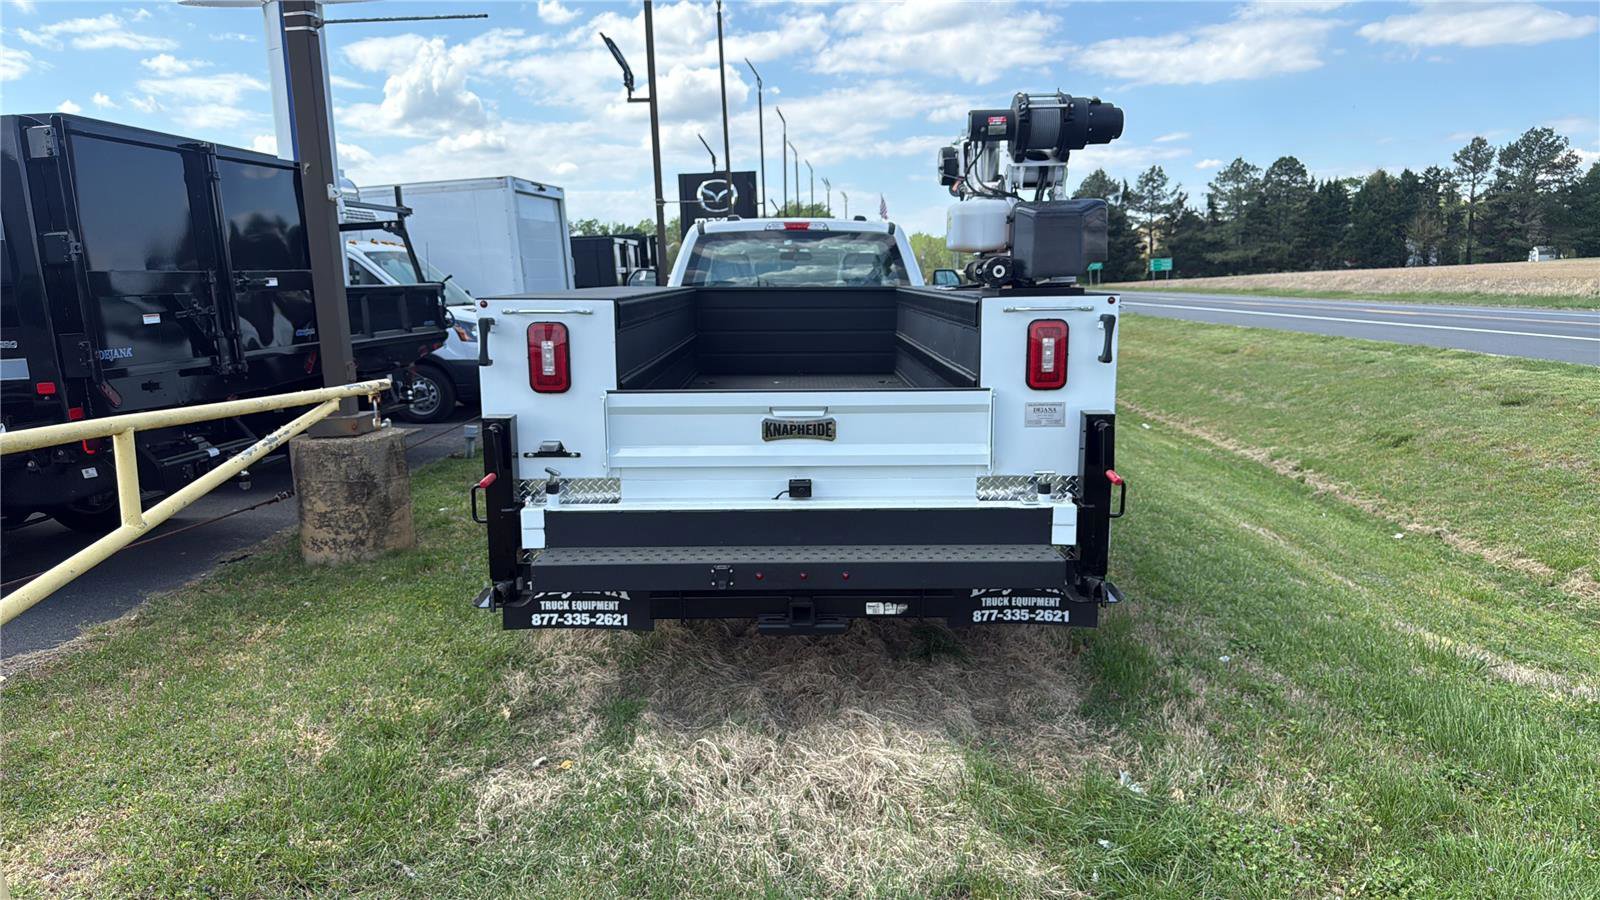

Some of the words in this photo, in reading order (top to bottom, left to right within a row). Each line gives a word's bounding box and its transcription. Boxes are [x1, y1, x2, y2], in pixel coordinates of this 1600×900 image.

[765, 421, 833, 438] KNAPHEIDE
[540, 600, 570, 611] TRUCK
[571, 600, 620, 611] EQUIPMENT
[981, 597, 1010, 607] TRUCK
[1011, 597, 1061, 607] EQUIPMENT
[531, 613, 629, 626] 877-335-2621
[972, 609, 1070, 622] 877-335-2621
